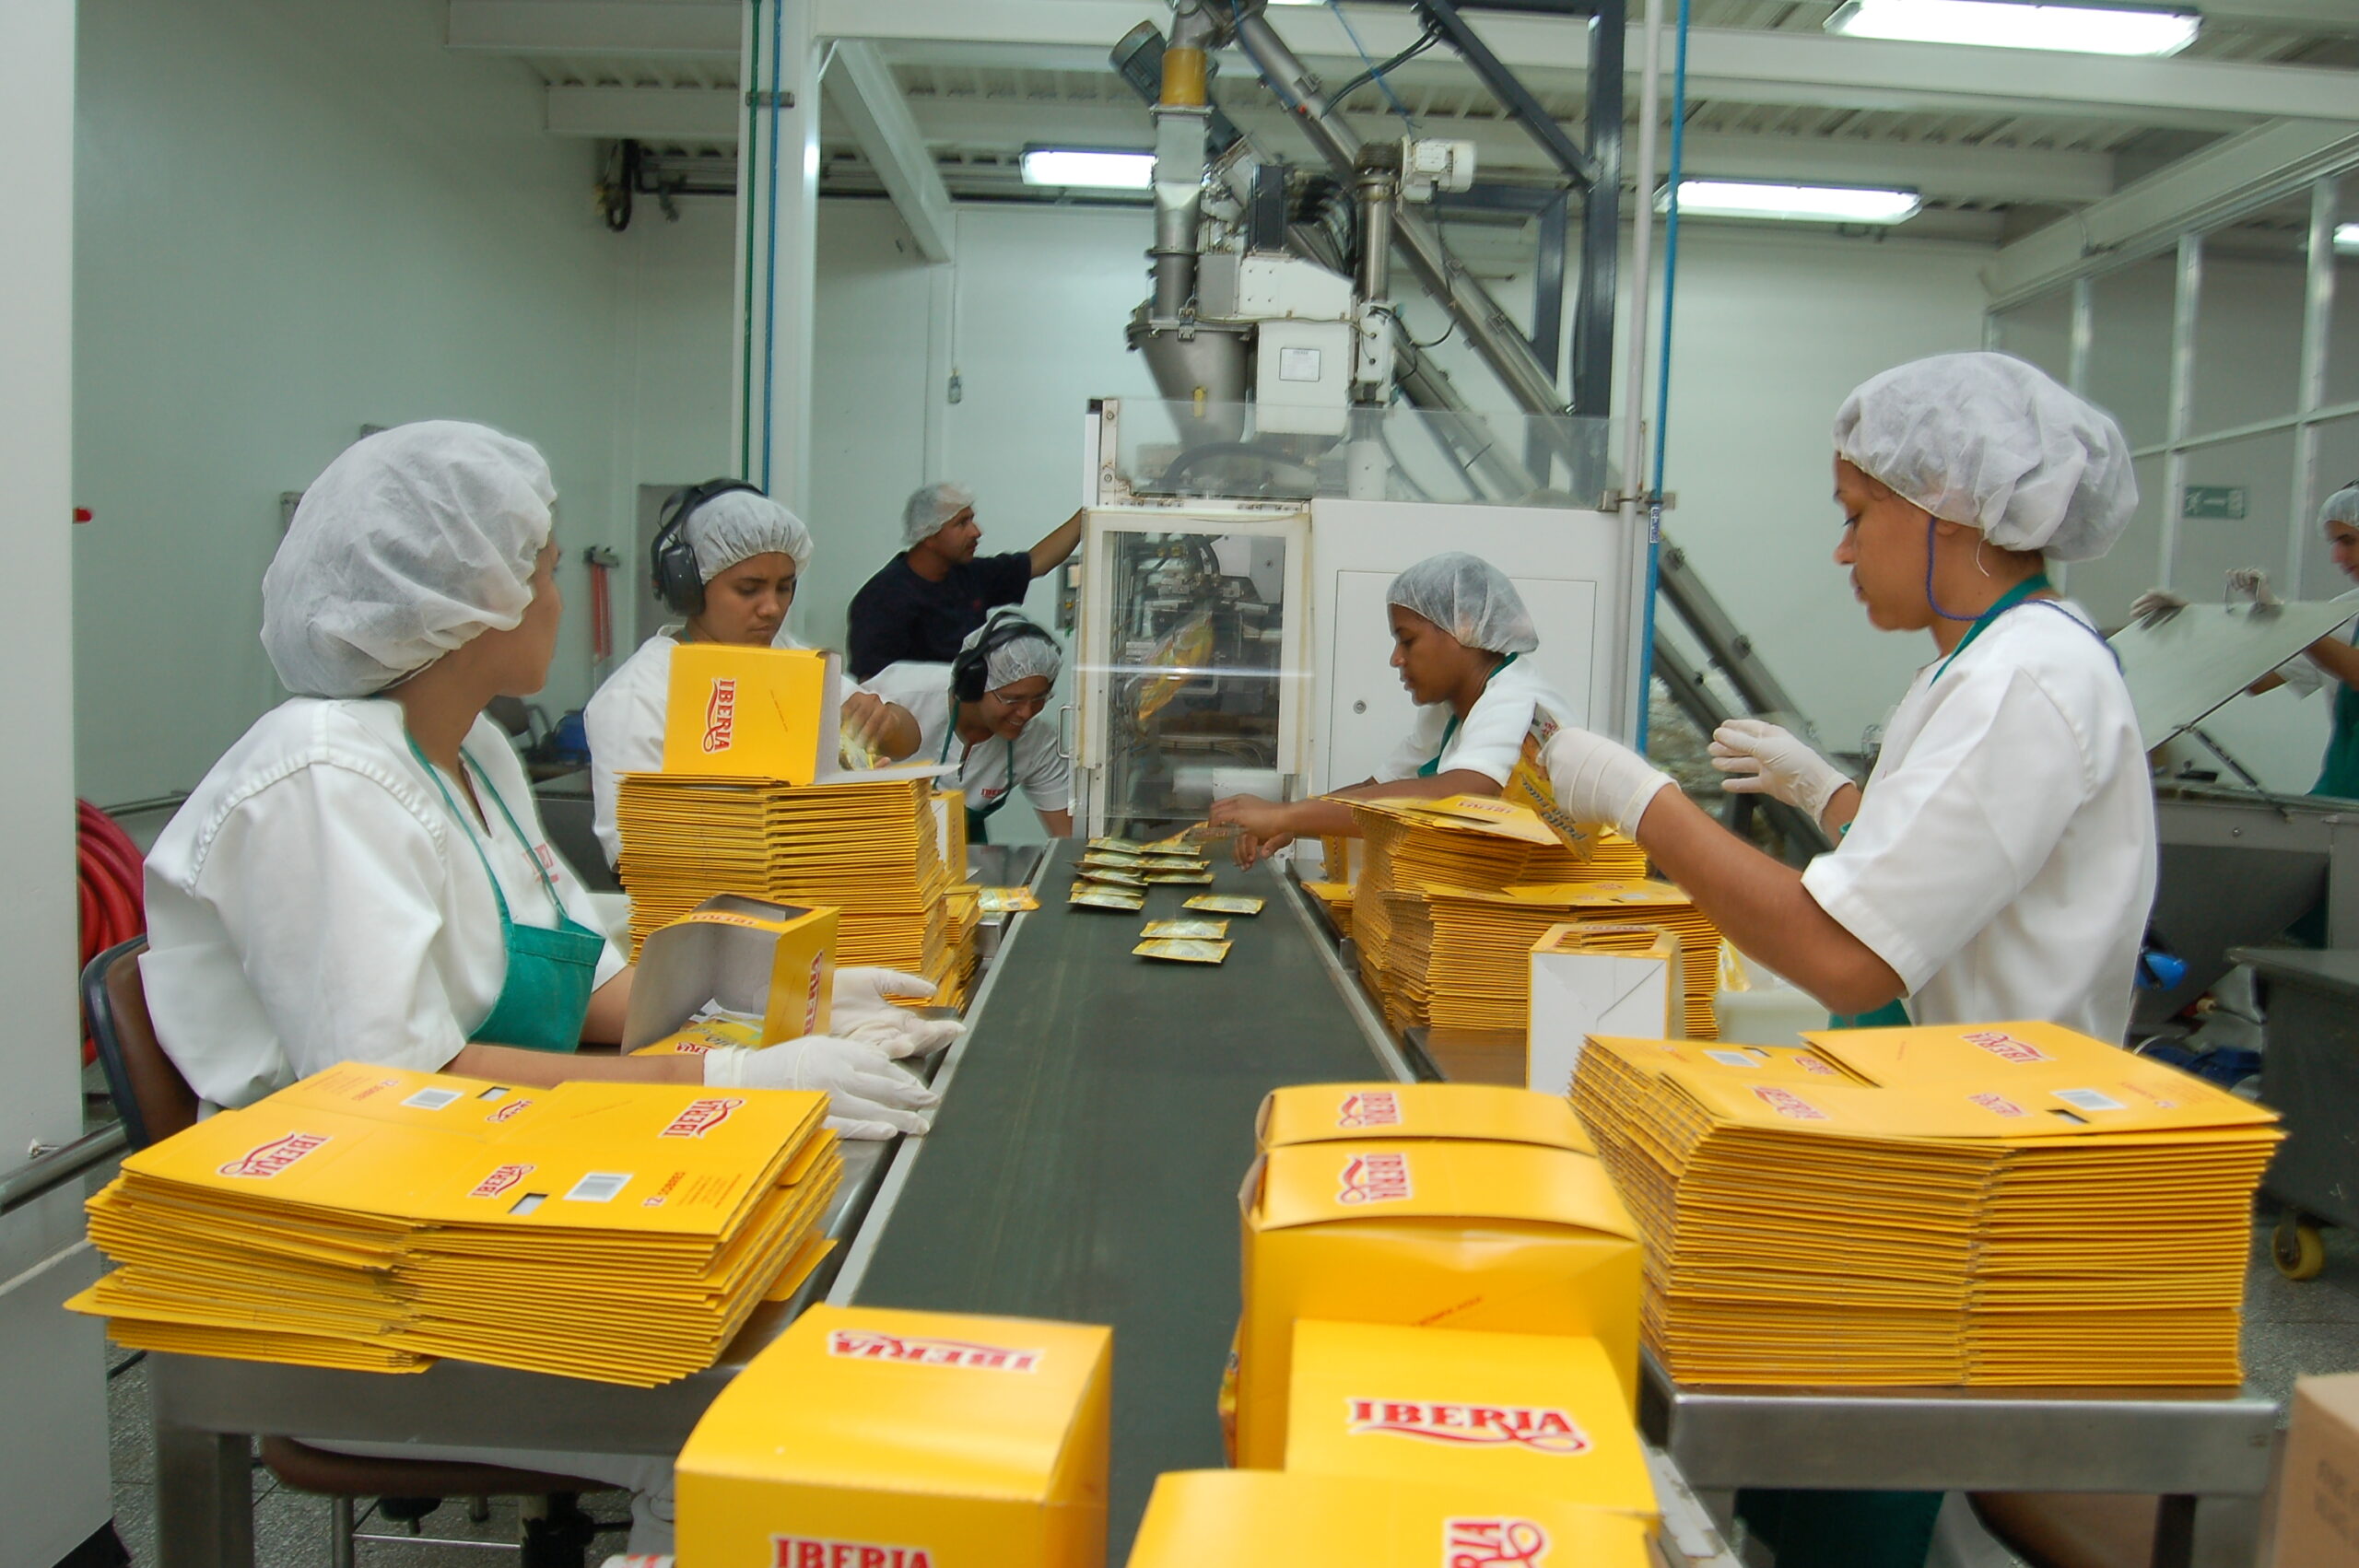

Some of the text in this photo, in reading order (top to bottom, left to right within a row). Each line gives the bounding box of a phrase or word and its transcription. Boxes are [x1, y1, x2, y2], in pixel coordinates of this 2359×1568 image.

[703, 679, 736, 753] IBERIA
[1541, 812, 1589, 840] Pollo
[1961, 1032, 2042, 1062] IBERIA
[662, 1098, 744, 1137] IBERIA
[219, 1133, 330, 1176] IBERIA
[472, 1165, 534, 1197] IBERIA
[834, 1330, 1039, 1371] IBERIA
[1353, 1401, 1586, 1453] IBERIA
